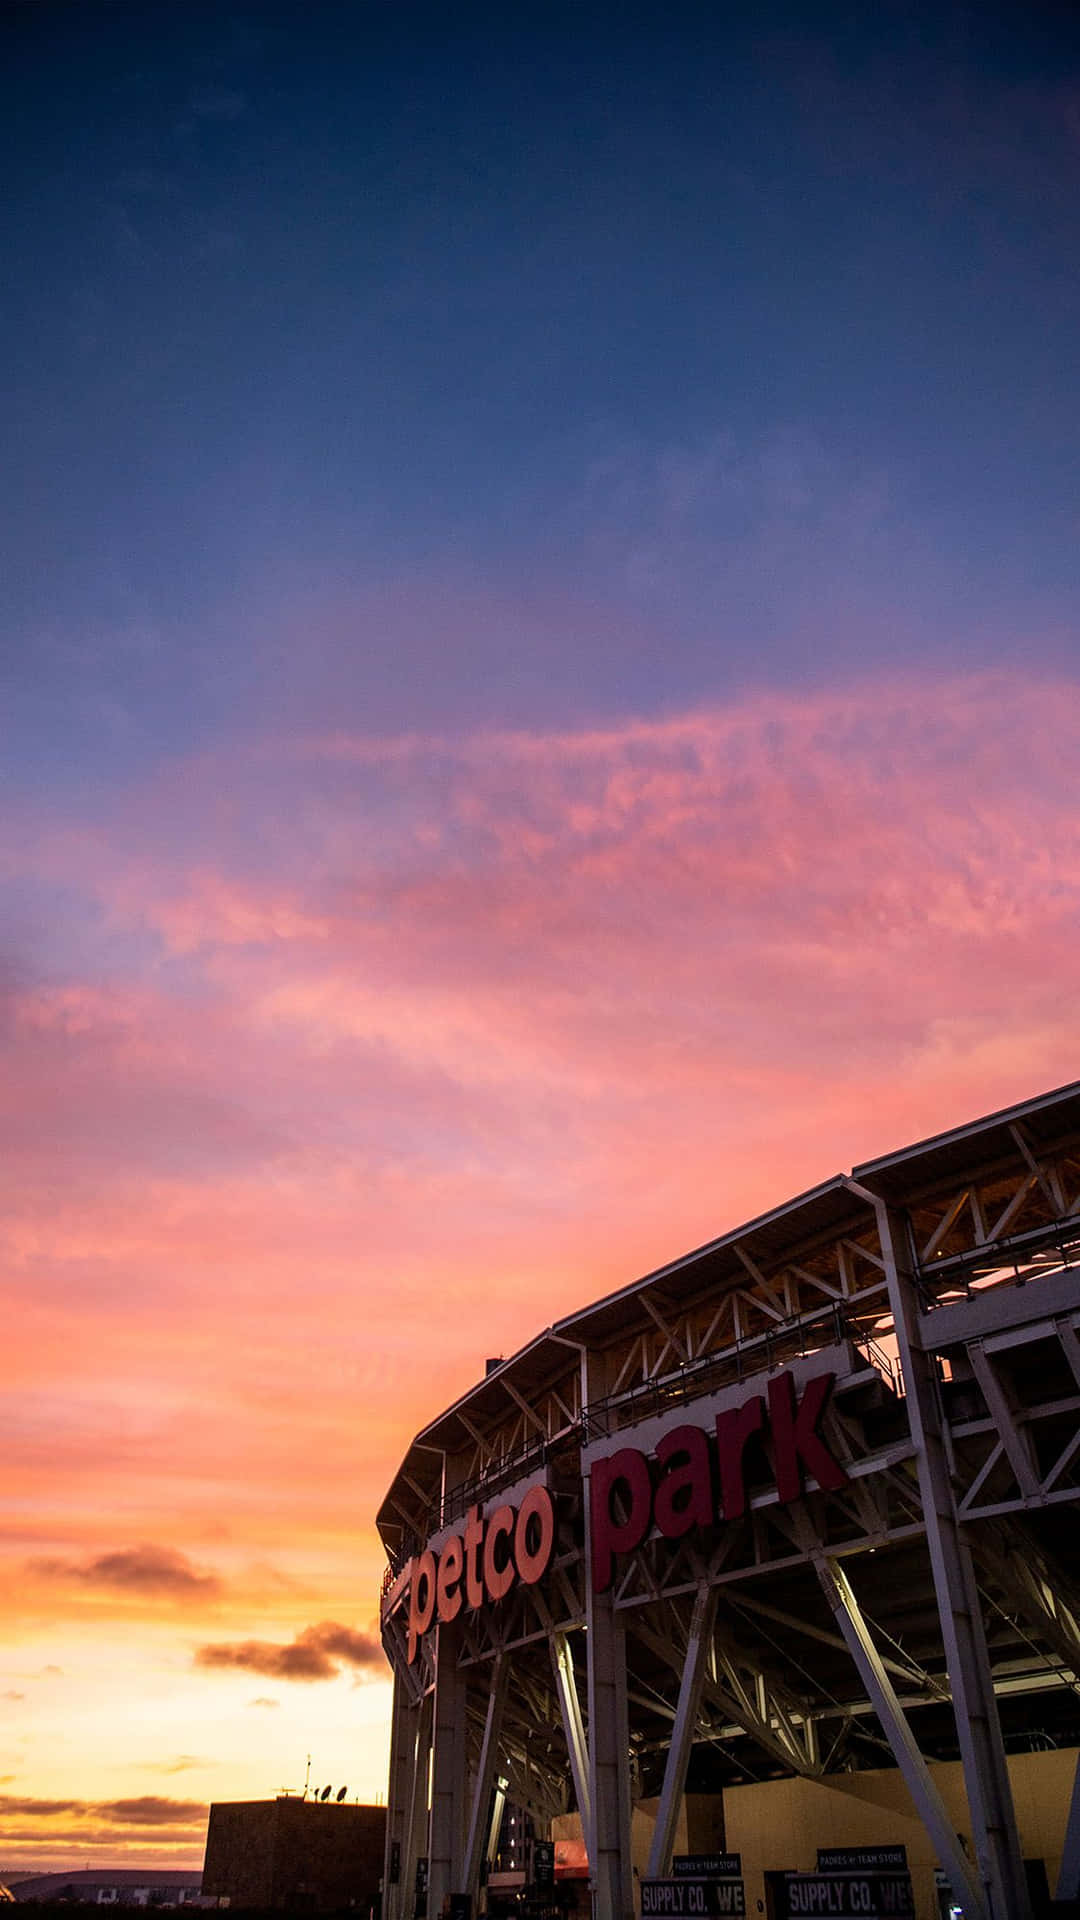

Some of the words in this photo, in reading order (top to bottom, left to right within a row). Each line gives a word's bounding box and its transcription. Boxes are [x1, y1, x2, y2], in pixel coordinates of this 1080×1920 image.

[407, 1485, 555, 1665] petco
[590, 1370, 848, 1594] park
[643, 1885, 684, 1912] SUPPLY
[688, 1885, 708, 1912] CO.
[717, 1885, 743, 1912] WE
[789, 1882, 844, 1912] SUPPLY
[849, 1881, 877, 1911] CO.
